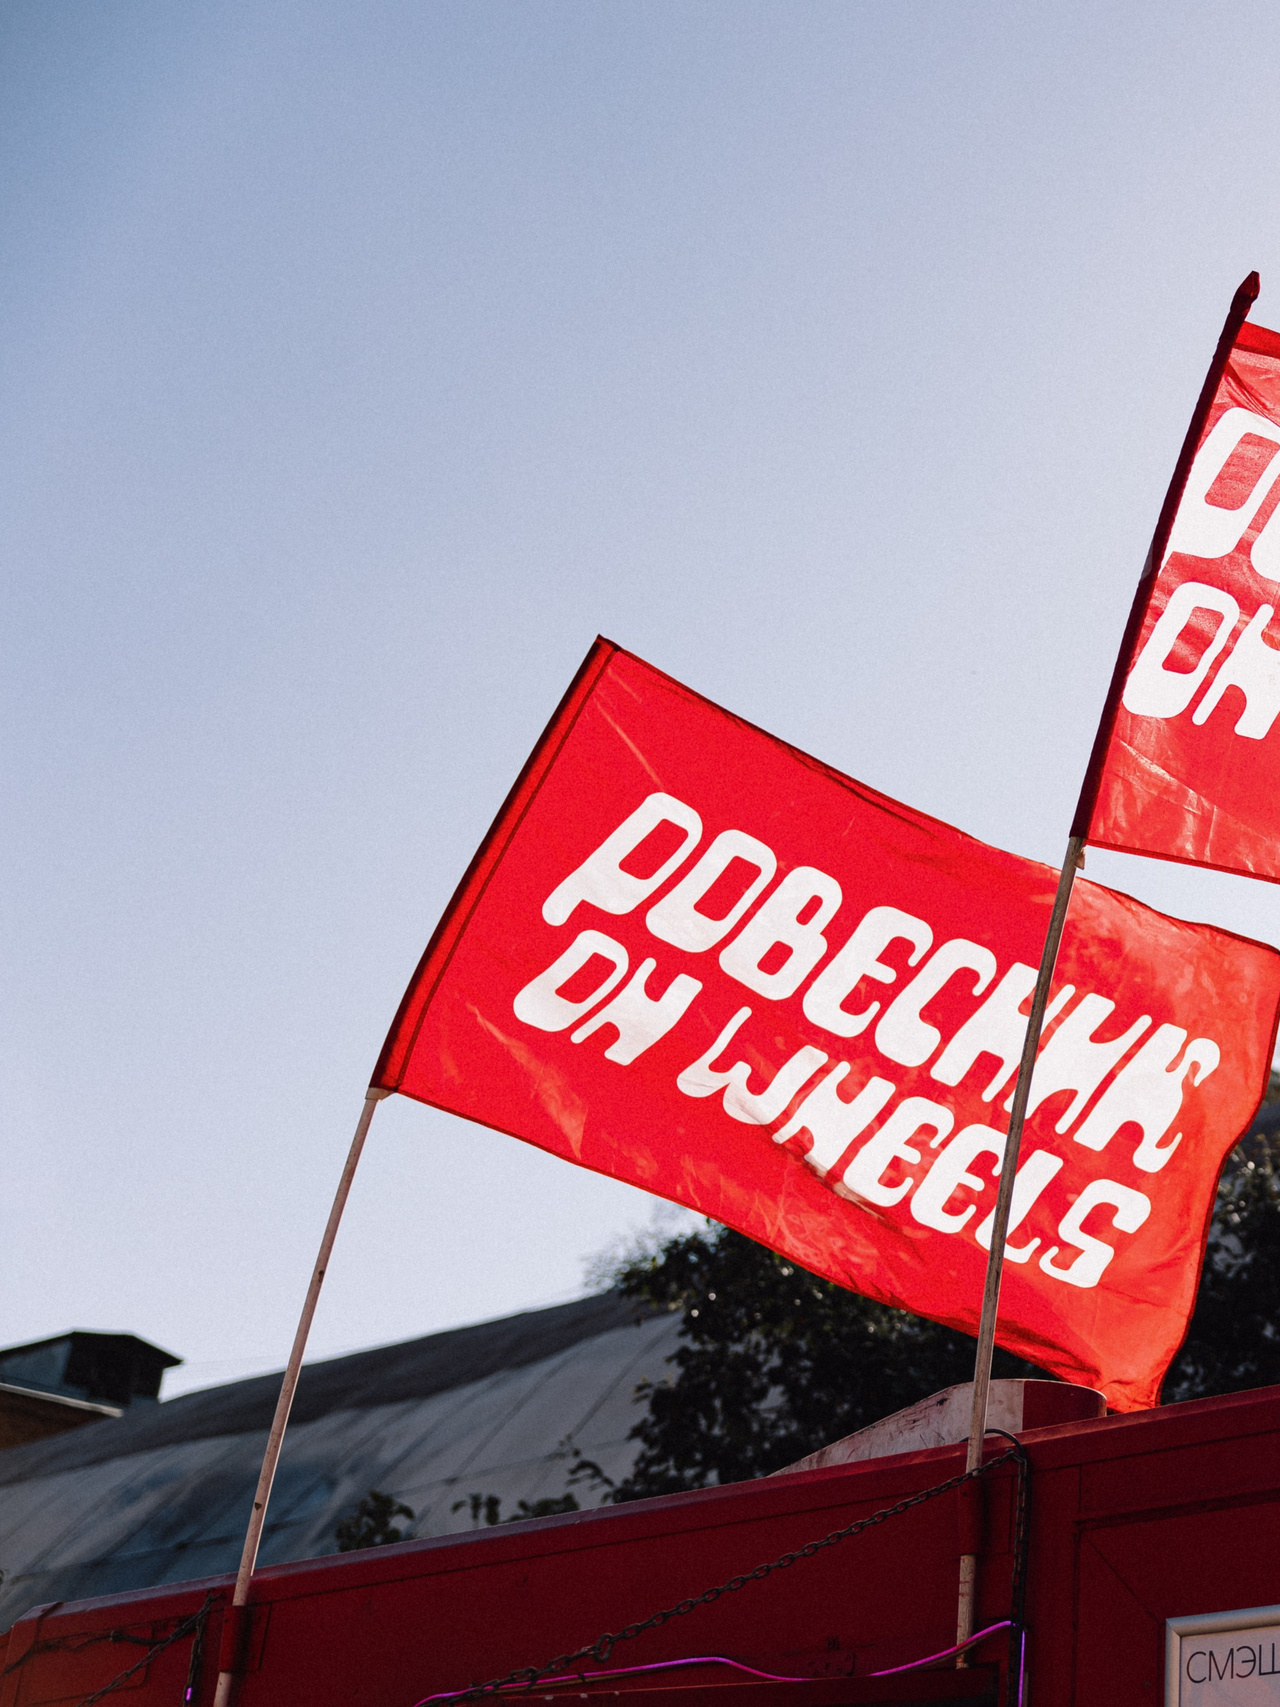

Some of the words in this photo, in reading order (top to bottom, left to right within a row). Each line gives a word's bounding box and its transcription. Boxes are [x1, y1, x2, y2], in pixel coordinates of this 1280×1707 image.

[513, 929, 703, 1066] ON
[676, 1006, 1152, 1289] WHEELS
[542, 792, 1221, 1174] РОВЕСНИК
